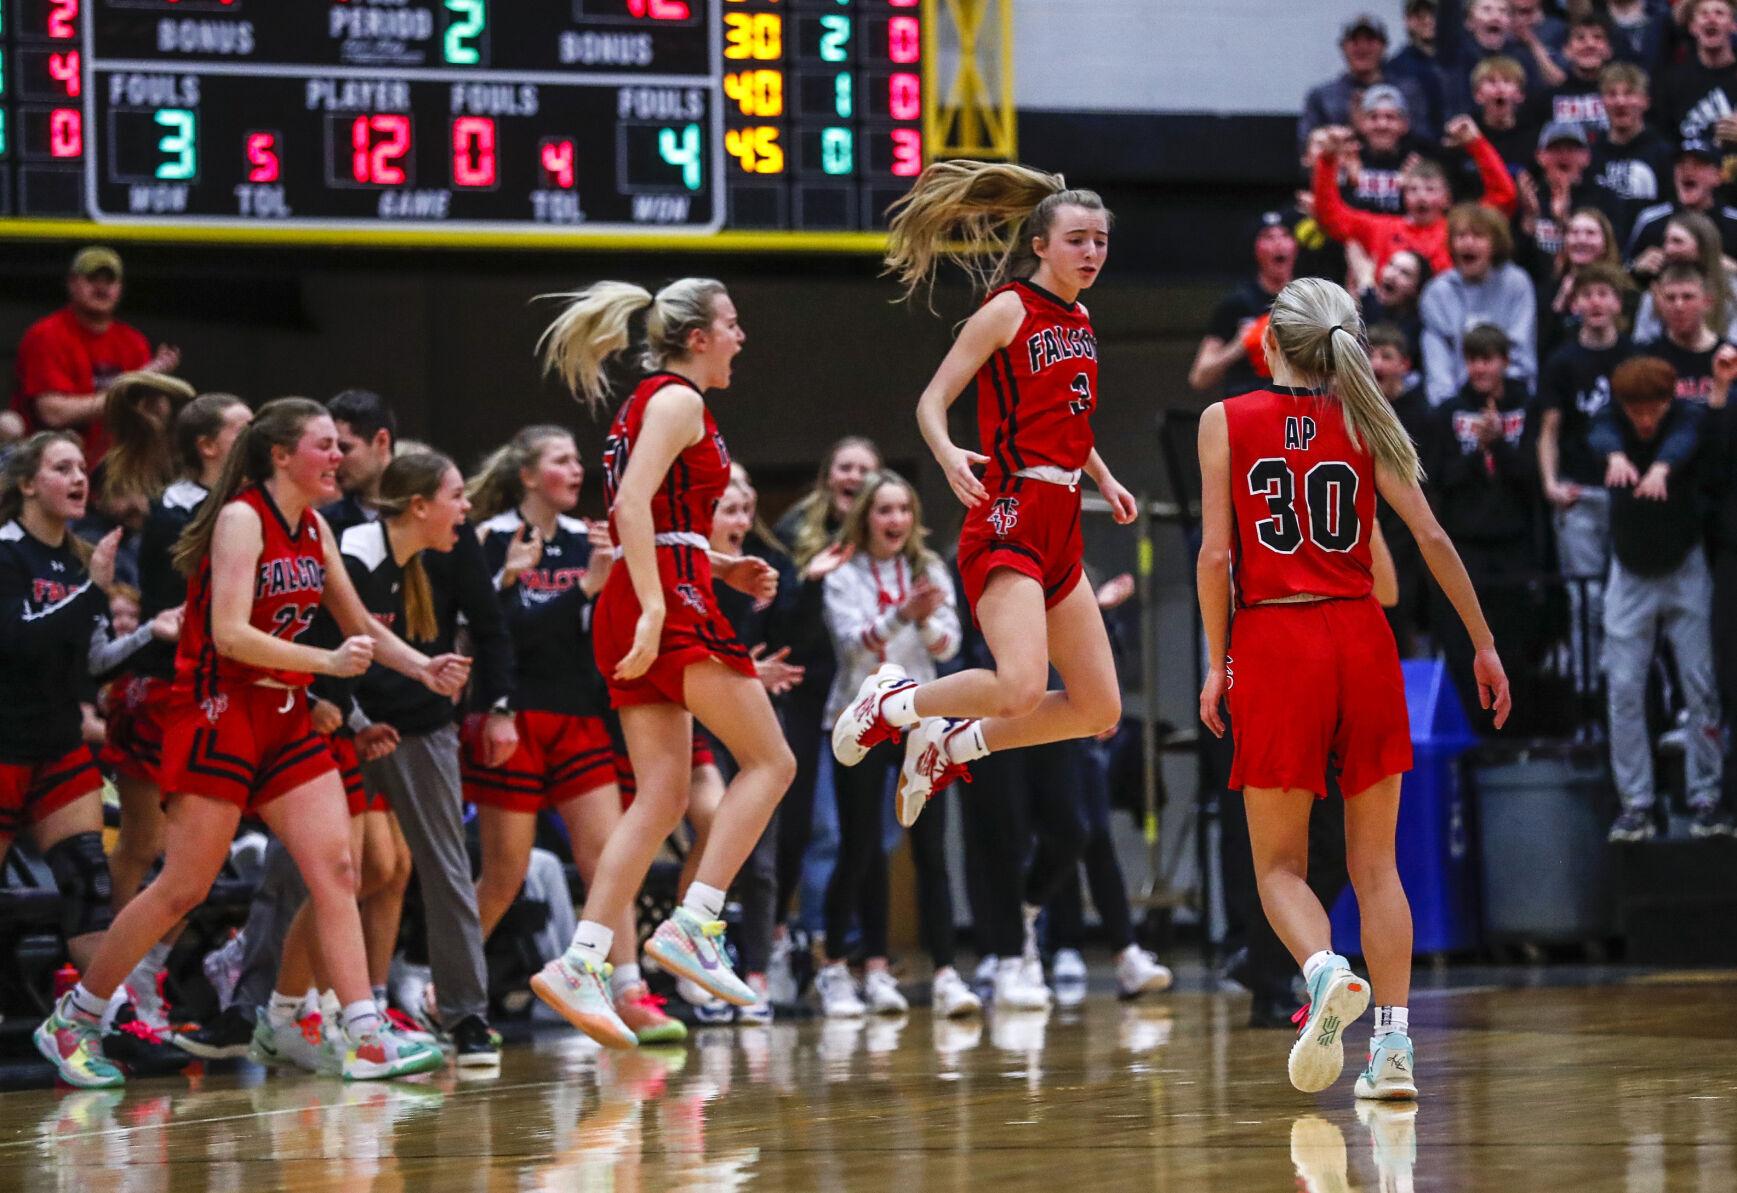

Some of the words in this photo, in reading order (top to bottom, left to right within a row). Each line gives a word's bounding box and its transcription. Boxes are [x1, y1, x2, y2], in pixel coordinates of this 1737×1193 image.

[48, 0, 78, 38] 2
[157, 18, 255, 54] BONUS
[328, 7, 434, 40] PERIOD
[443, 0, 486, 64] 2
[723, 12, 782, 60] 30
[819, 14, 851, 62] 2
[888, 16, 920, 63] 0
[559, 31, 653, 66] BONUS
[49, 50, 80, 97] 4
[109, 72, 200, 106] FOULS
[723, 69, 783, 117] 40
[889, 72, 921, 120] 0
[305, 80, 411, 111] PLAYER
[451, 83, 539, 116] FOULS
[617, 87, 704, 119] FOULS
[51, 108, 82, 157] 0
[154, 109, 197, 180] 3
[352, 114, 411, 185] 12
[453, 116, 496, 187] 0
[658, 122, 702, 190] 4
[725, 126, 784, 174] 45
[821, 127, 854, 175] 0
[890, 128, 922, 177] 3
[246, 132, 281, 183] 5
[541, 140, 575, 188] 4
[377, 190, 451, 218] GAME
[1069, 372, 1092, 415] 3
[1285, 416, 1316, 450] AP
[1247, 457, 1361, 554] 30
